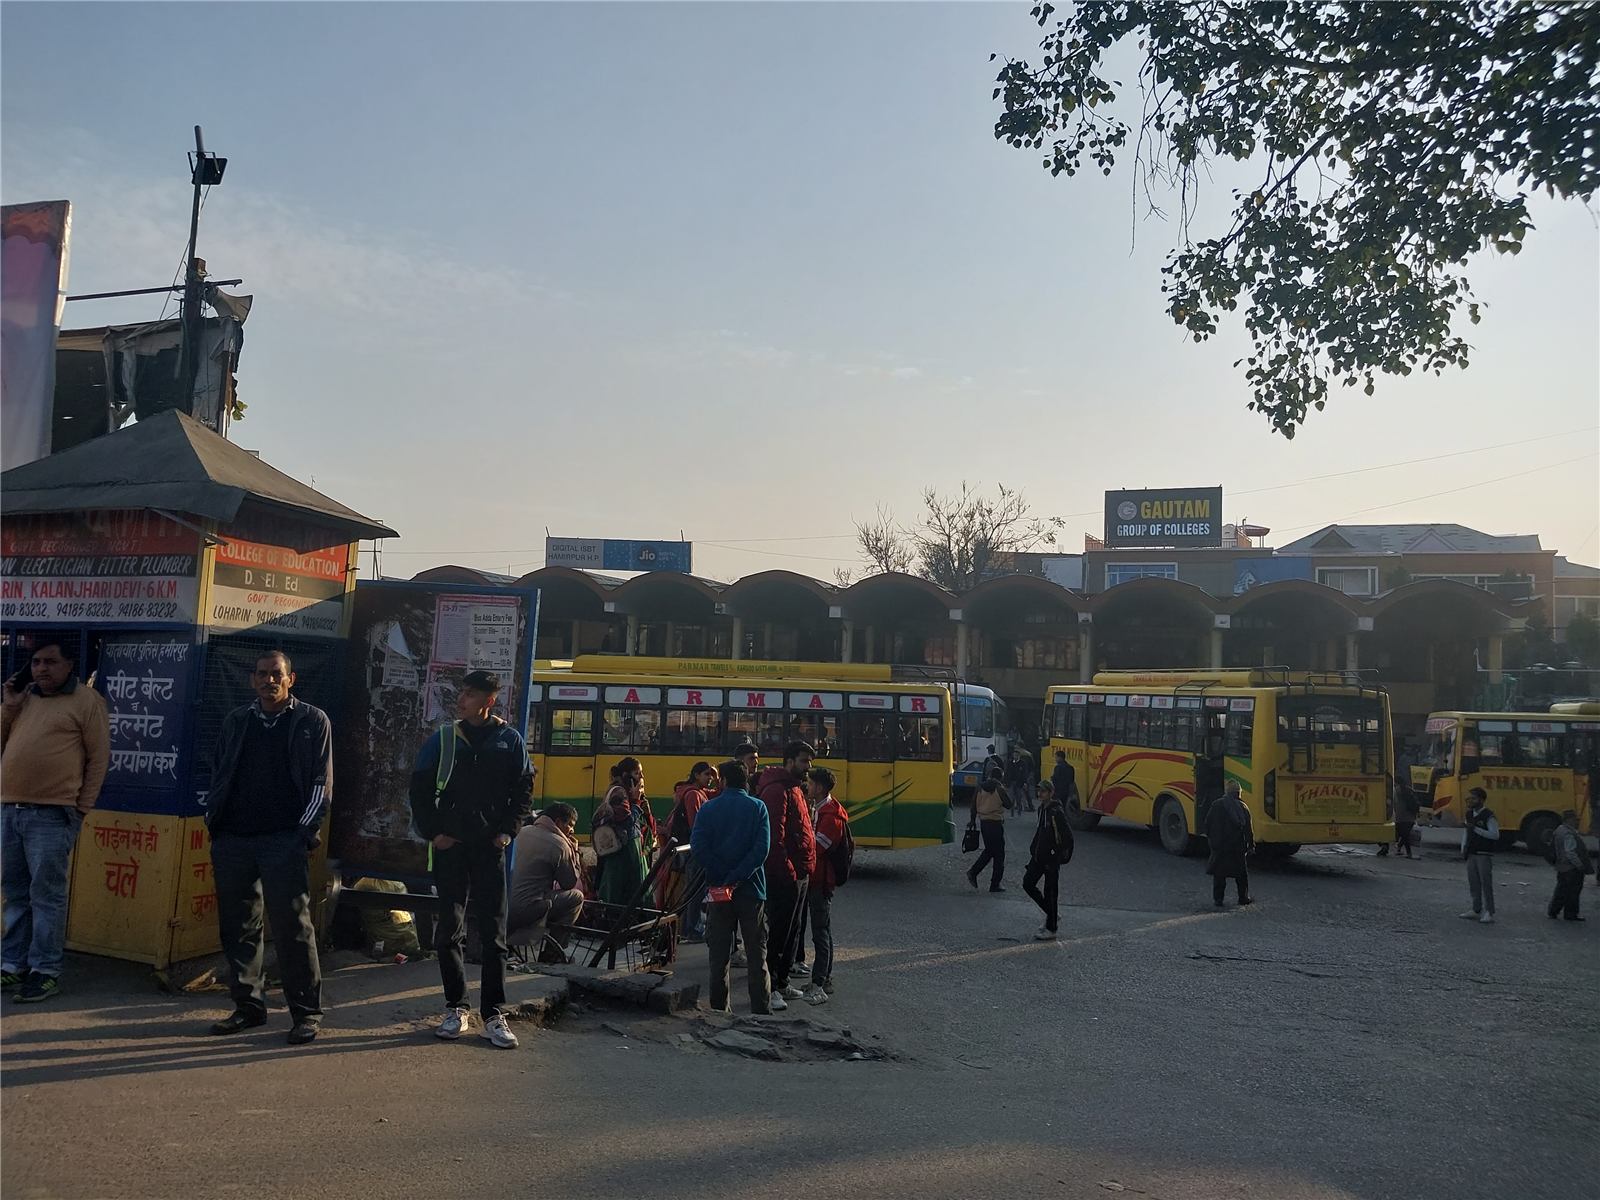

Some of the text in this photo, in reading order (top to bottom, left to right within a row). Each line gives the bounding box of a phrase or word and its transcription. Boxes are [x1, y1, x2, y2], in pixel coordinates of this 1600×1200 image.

[1140, 499, 1210, 519] GAUTAM
[1117, 523, 1210, 537] GROUP OF COLLEGES
[548, 553, 586, 561] HAMIRPUR
[552, 544, 596, 553] DIGITAL ISBT
[639, 550, 656, 561] Jio
[139, 556, 192, 576] PLUMBER
[220, 543, 340, 577] COLLEGE OF EDUCATION
[106, 669, 174, 703] सीट बेल्ट
[1482, 776, 1562, 791] THAKUR
[1299, 784, 1364, 805] THAKUR
